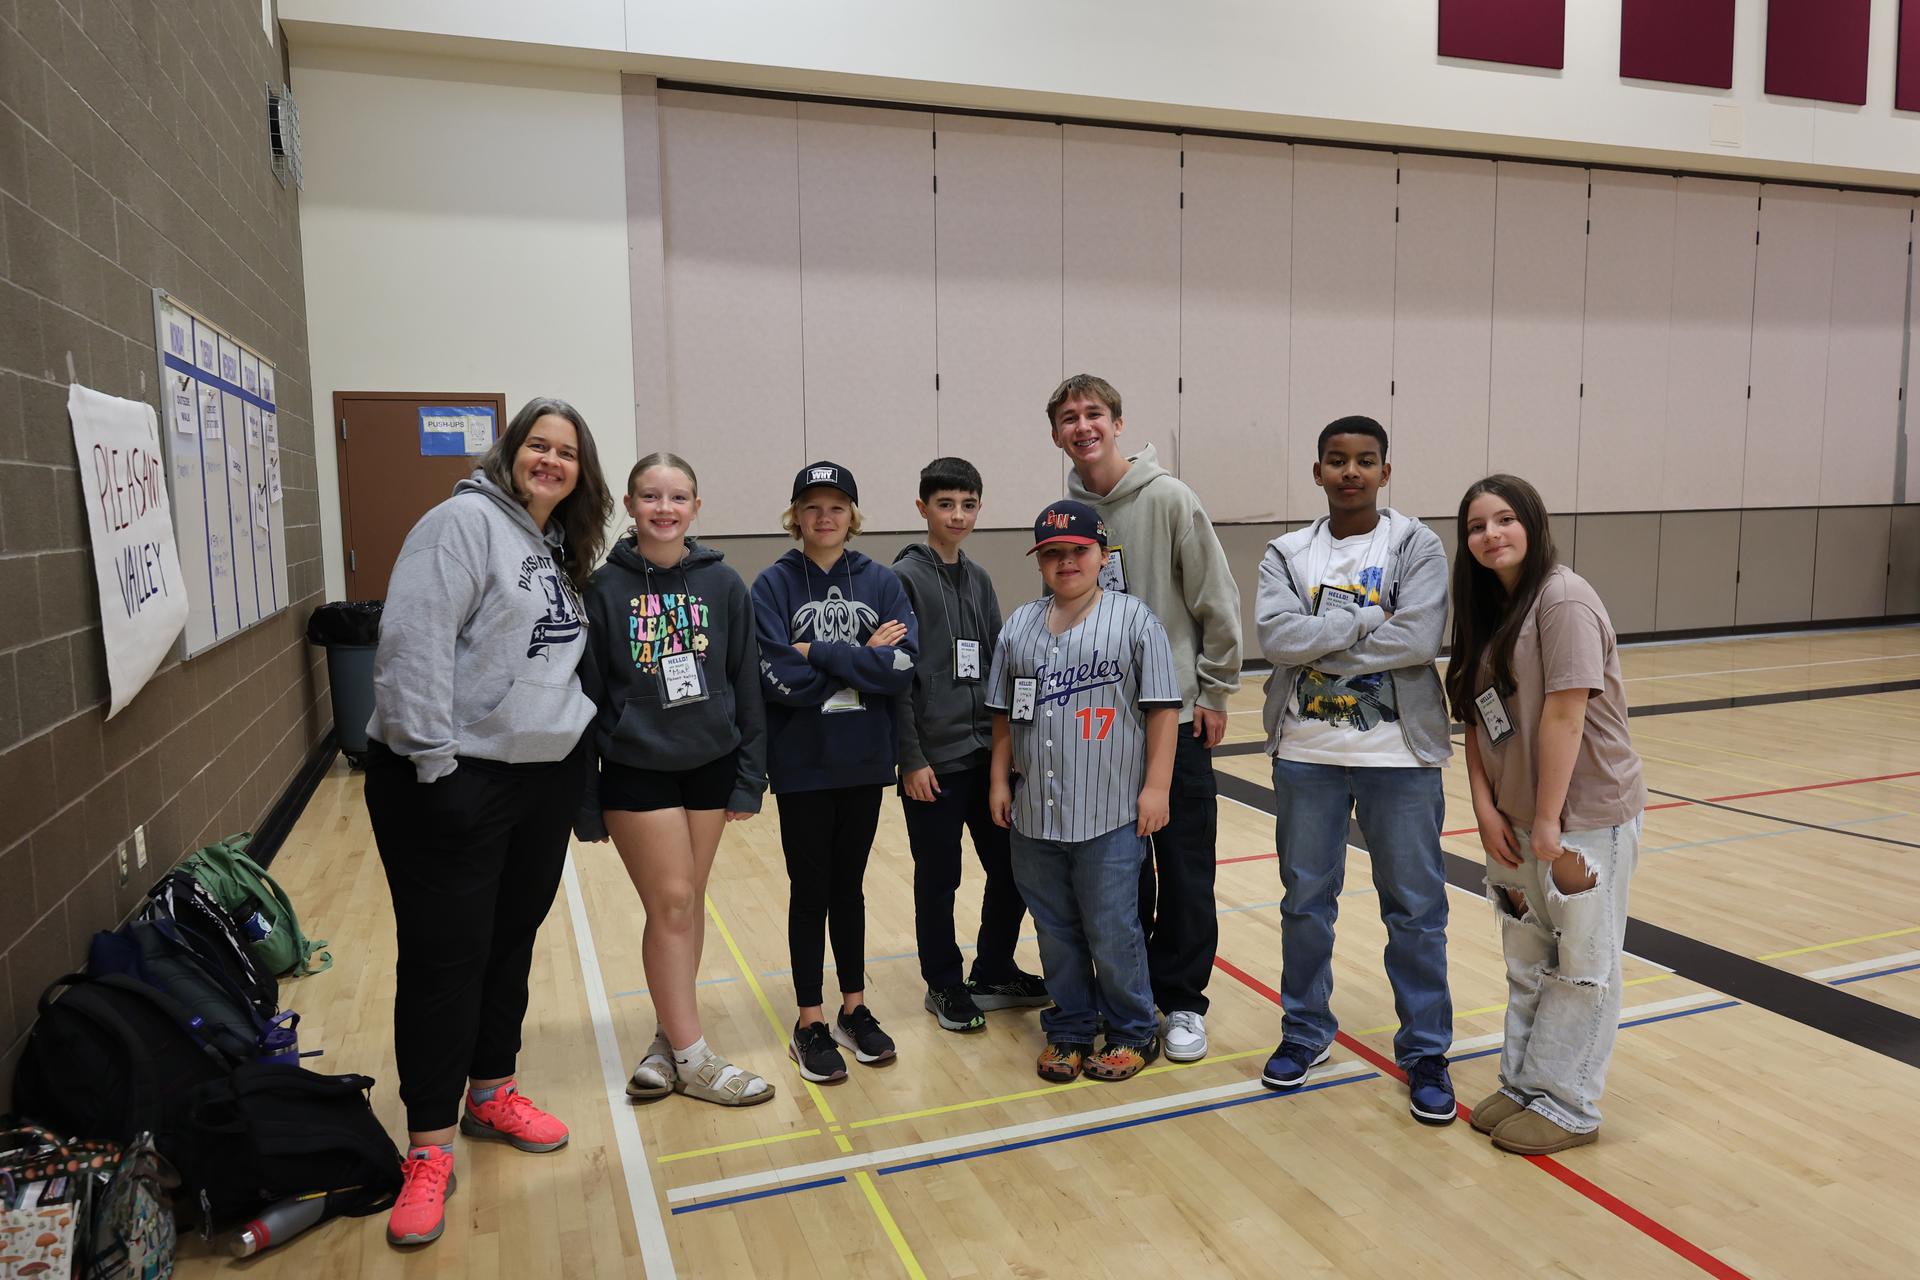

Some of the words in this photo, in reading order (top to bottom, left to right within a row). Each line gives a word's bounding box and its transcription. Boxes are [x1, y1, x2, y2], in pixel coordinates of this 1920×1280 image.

[93, 443, 163, 533] PLEASANT
[115, 540, 168, 619] VALLEY
[1328, 591, 1348, 600] HELLO!
[639, 593, 661, 617] IN
[662, 593, 687, 611] MY
[668, 656, 688, 664] HELLO!
[758, 643, 792, 695] AII
[1036, 650, 1122, 707] Angeles
[1075, 706, 1116, 741] 17
